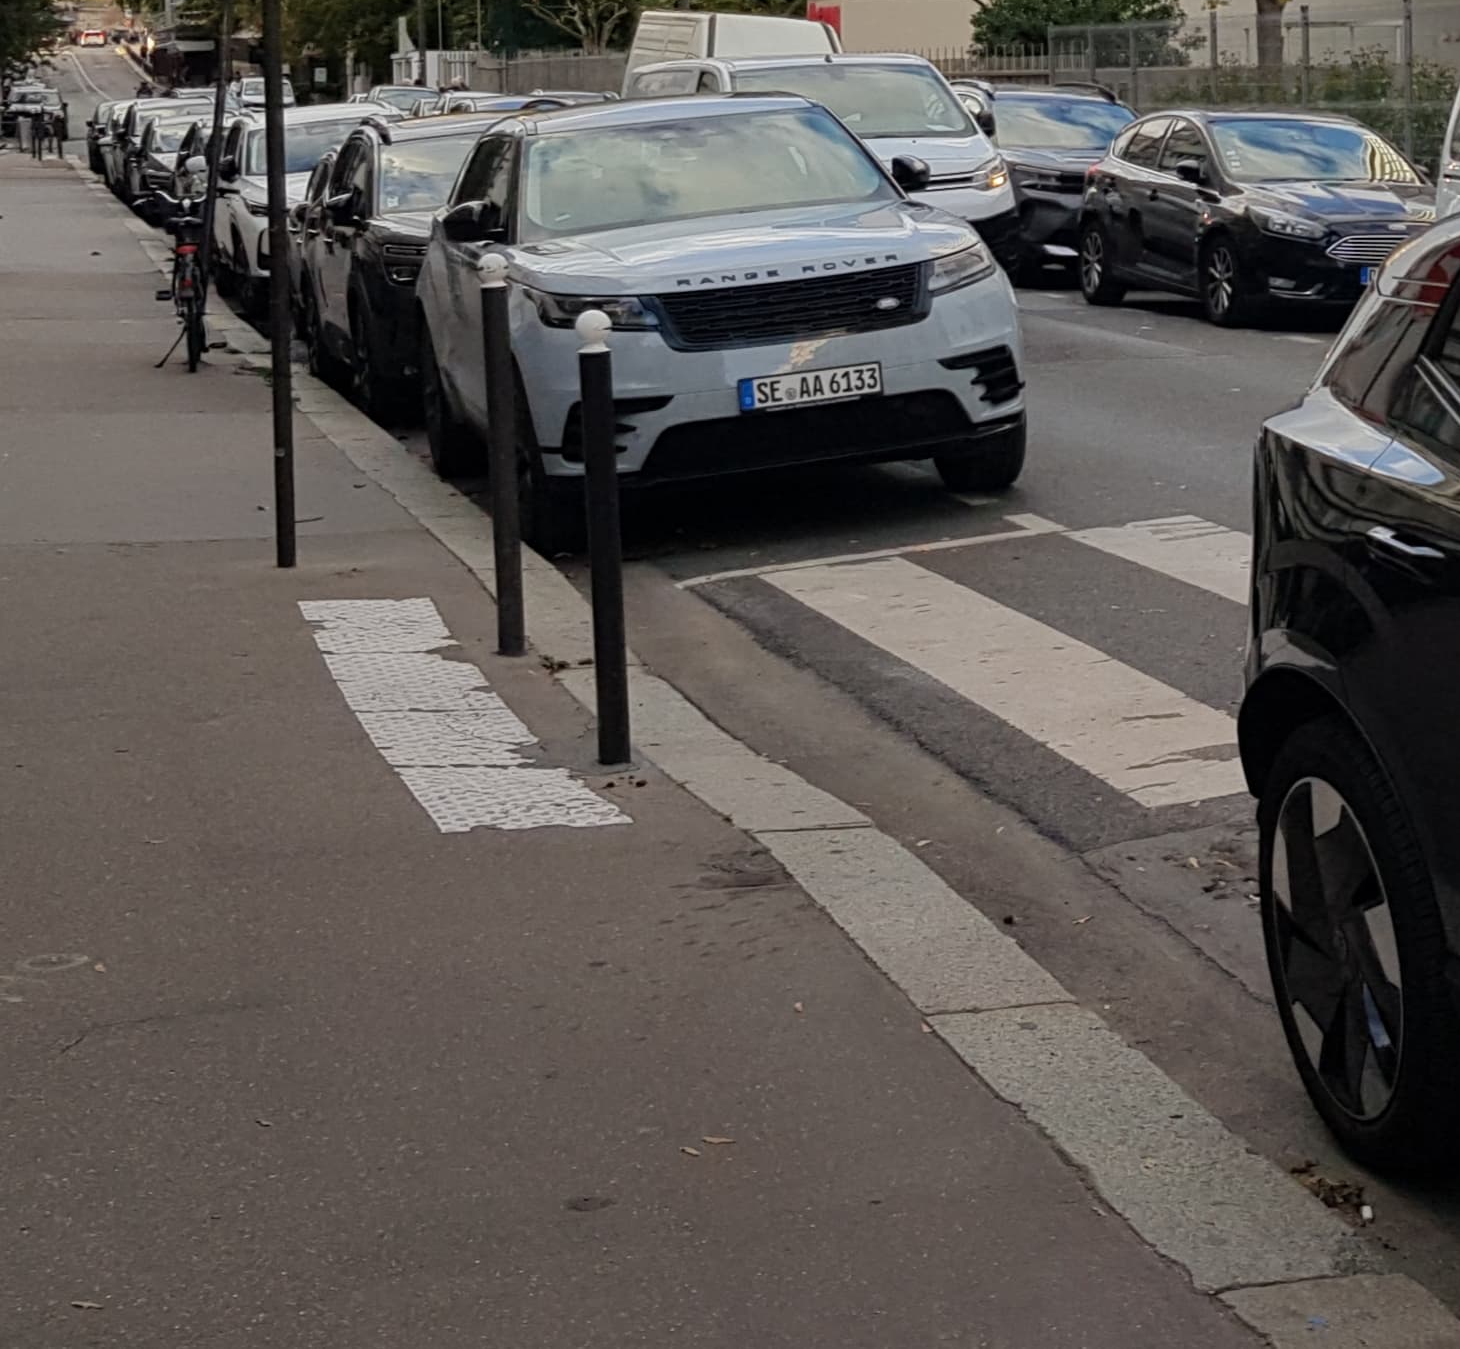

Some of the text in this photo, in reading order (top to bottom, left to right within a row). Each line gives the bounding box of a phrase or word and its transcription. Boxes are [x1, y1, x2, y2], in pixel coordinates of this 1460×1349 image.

[676, 254, 899, 287] RANGE ROVER
[756, 380, 783, 404] SE
[799, 375, 825, 399] AA
[829, 368, 879, 394] 6133
